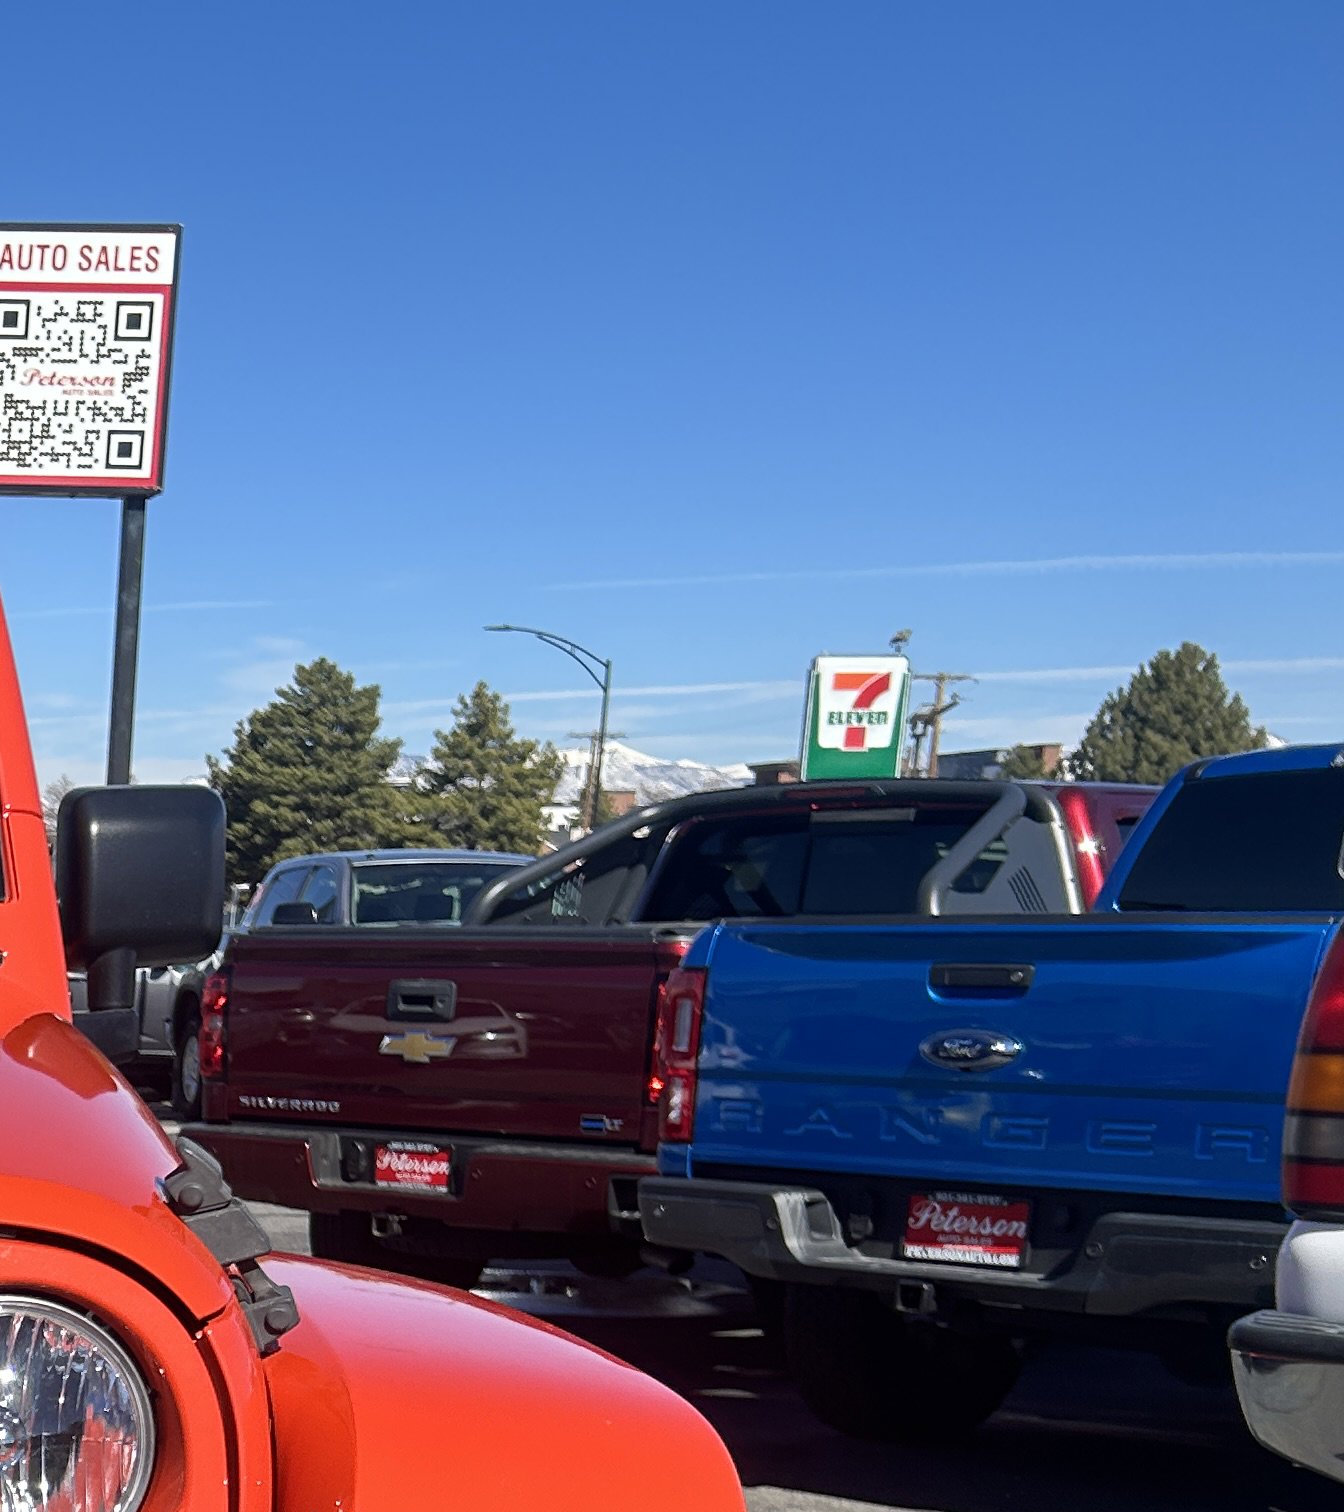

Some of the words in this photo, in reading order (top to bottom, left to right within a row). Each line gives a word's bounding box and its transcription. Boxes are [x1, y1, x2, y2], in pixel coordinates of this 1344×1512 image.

[77, 244, 161, 273] SALES
[238, 1095, 341, 1113] SILVERADO
[711, 1099, 1270, 1162] RANGER
[908, 1200, 1026, 1239] Peterson
